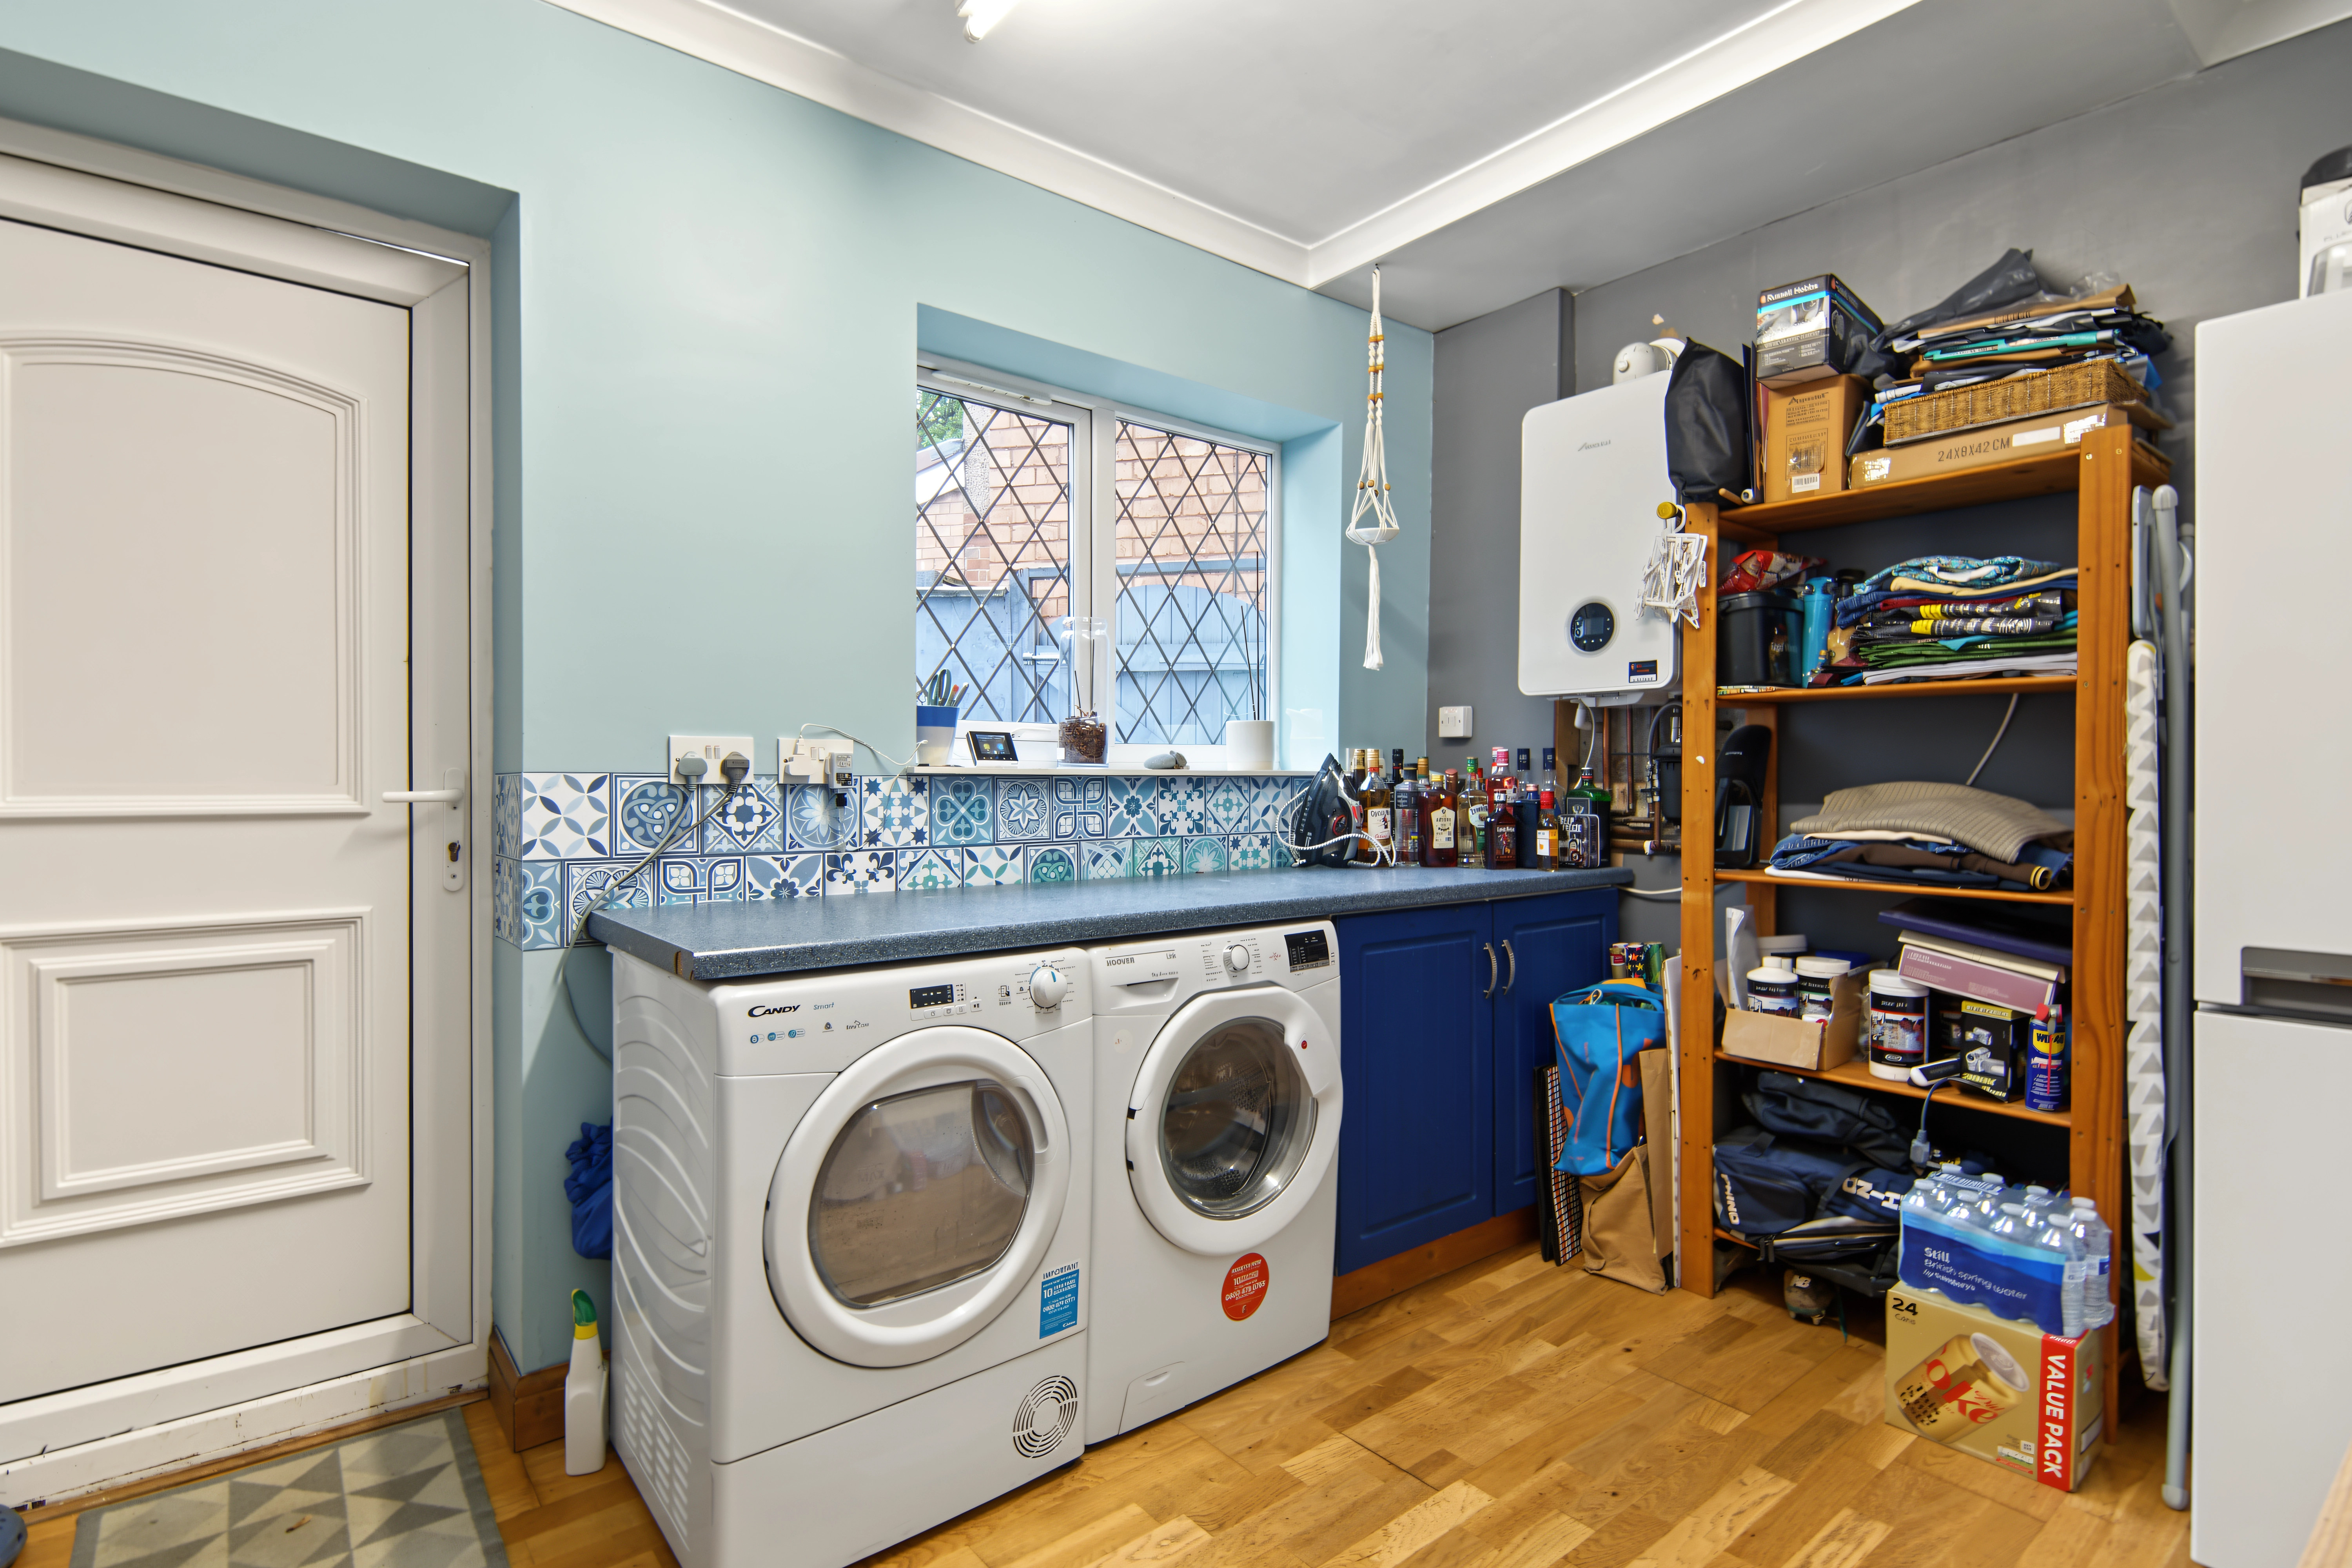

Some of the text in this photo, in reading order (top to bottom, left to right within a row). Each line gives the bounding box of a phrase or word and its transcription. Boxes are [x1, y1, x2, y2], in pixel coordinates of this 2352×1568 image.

[1993, 437, 2010, 450] CM
[1107, 957, 1135, 966] HOOVER
[748, 1004, 801, 1018] CANDY
[813, 1002, 834, 1010] Smart
[1924, 1247, 1950, 1263] Still
[1993, 1285, 2027, 1299] water
[1892, 1297, 1918, 1316] 24
[2046, 1355, 2066, 1419] VALUE
[2043, 1422, 2063, 1478] PACK
